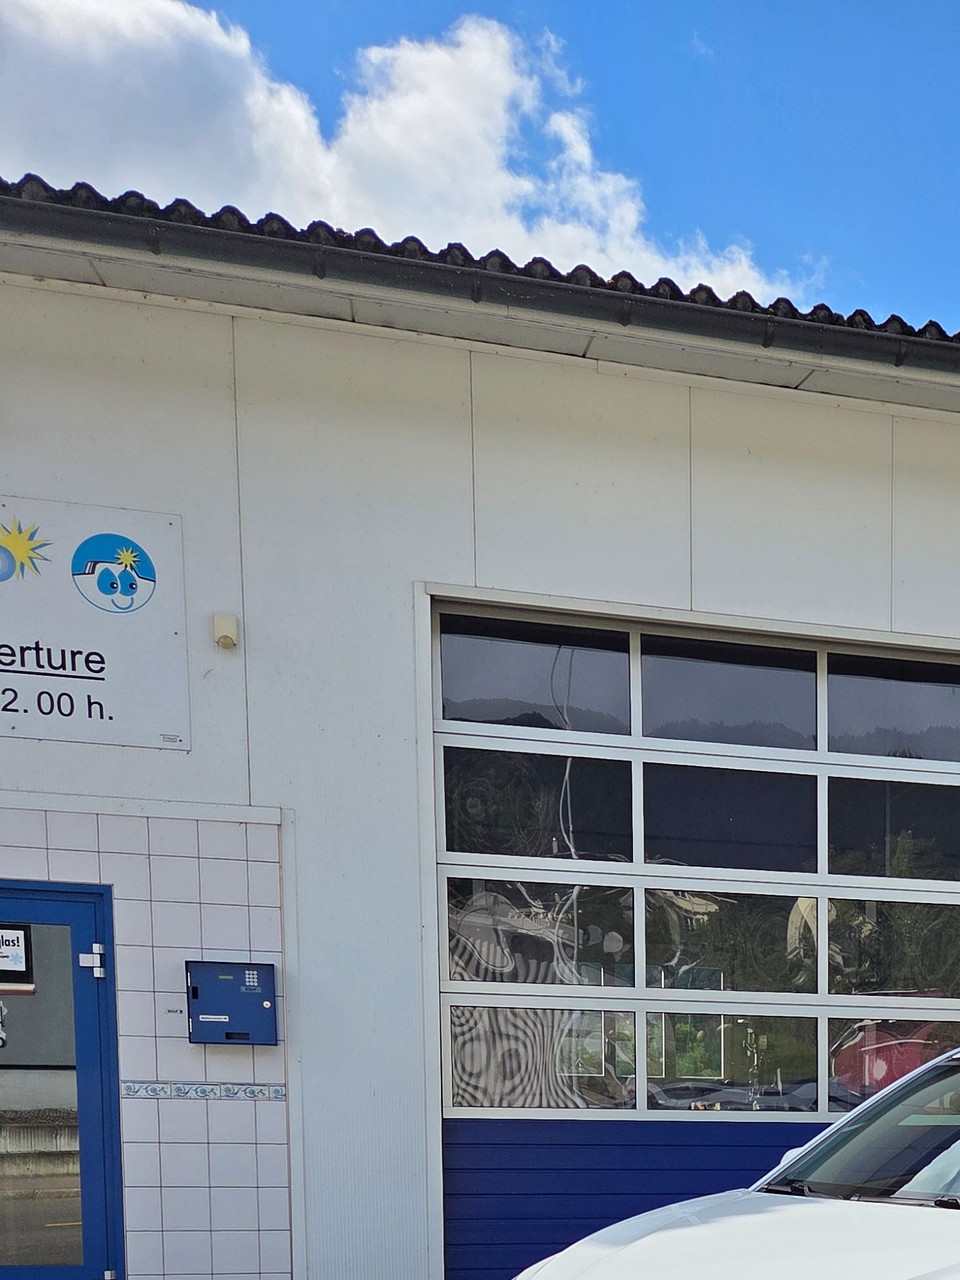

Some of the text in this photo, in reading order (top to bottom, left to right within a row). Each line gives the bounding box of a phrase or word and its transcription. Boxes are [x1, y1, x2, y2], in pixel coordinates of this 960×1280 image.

[0, 640, 106, 674] erture
[87, 694, 114, 721] h.
[0, 934, 20, 949] las!
